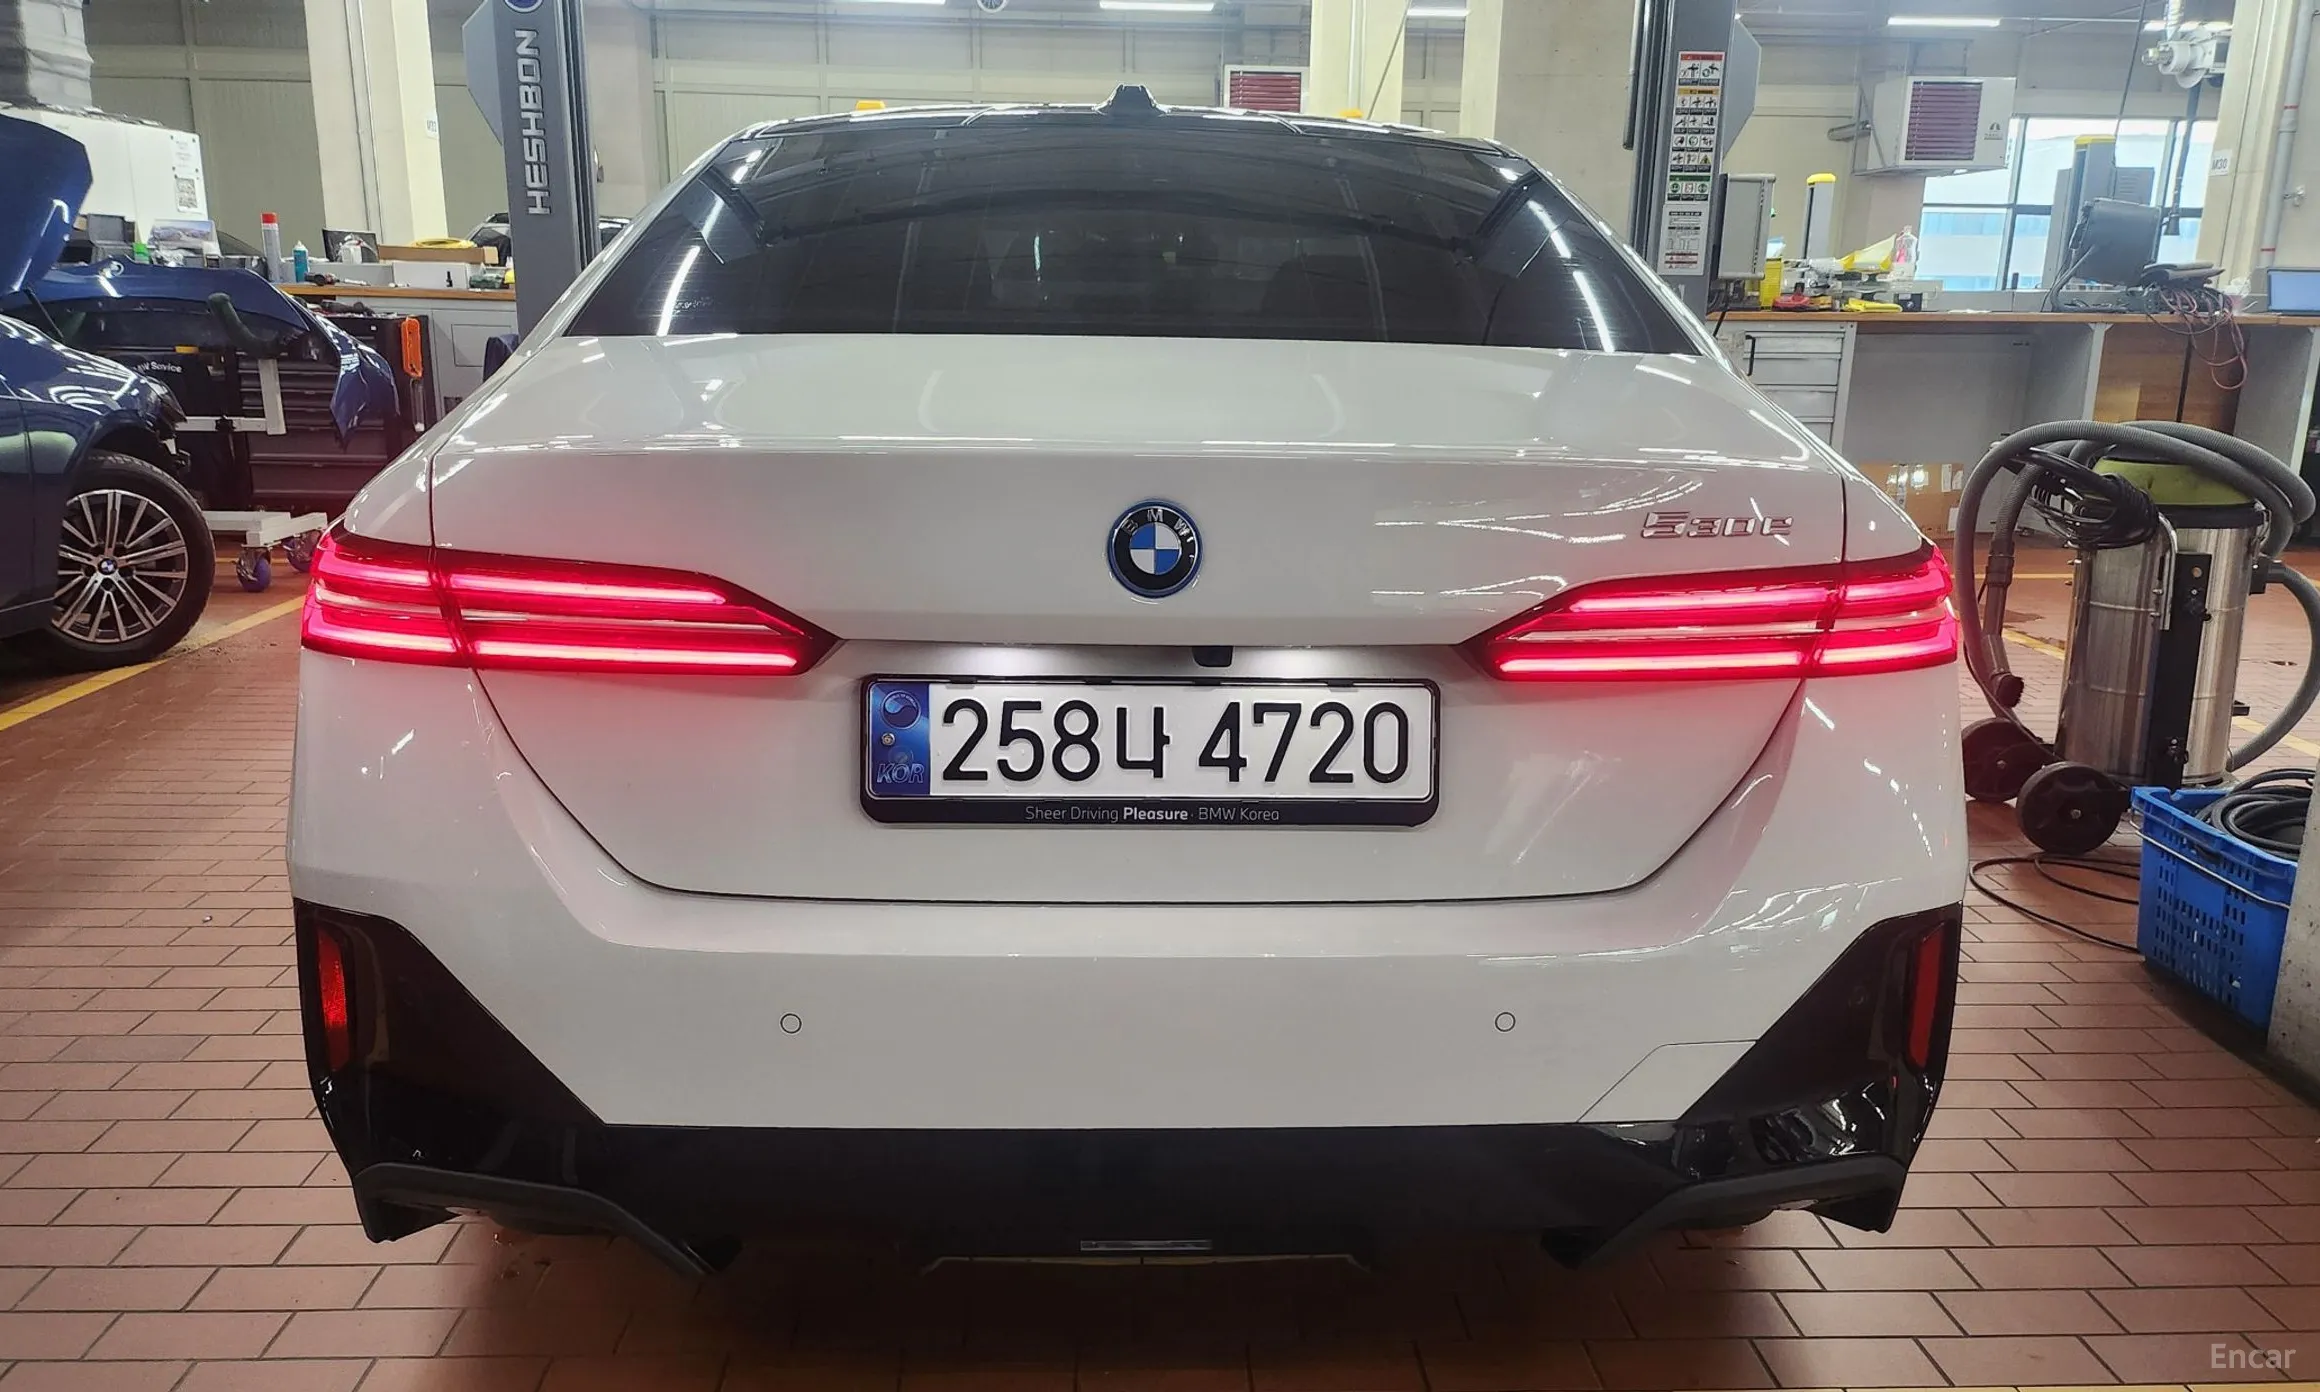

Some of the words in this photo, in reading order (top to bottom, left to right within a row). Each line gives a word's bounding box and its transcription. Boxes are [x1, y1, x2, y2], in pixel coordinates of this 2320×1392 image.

[514, 29, 550, 215] HESHBON
[1121, 508, 1192, 537] BMW
[942, 699, 1170, 783] 258나
[1198, 701, 1408, 784] 4720
[876, 763, 925, 784] KOR
[1025, 806, 1066, 820] Sheer
[1070, 806, 1119, 822] Driving
[1123, 807, 1188, 821] Pleasure
[1199, 808, 1235, 821] BMW
[1240, 808, 1280, 821] Korea
